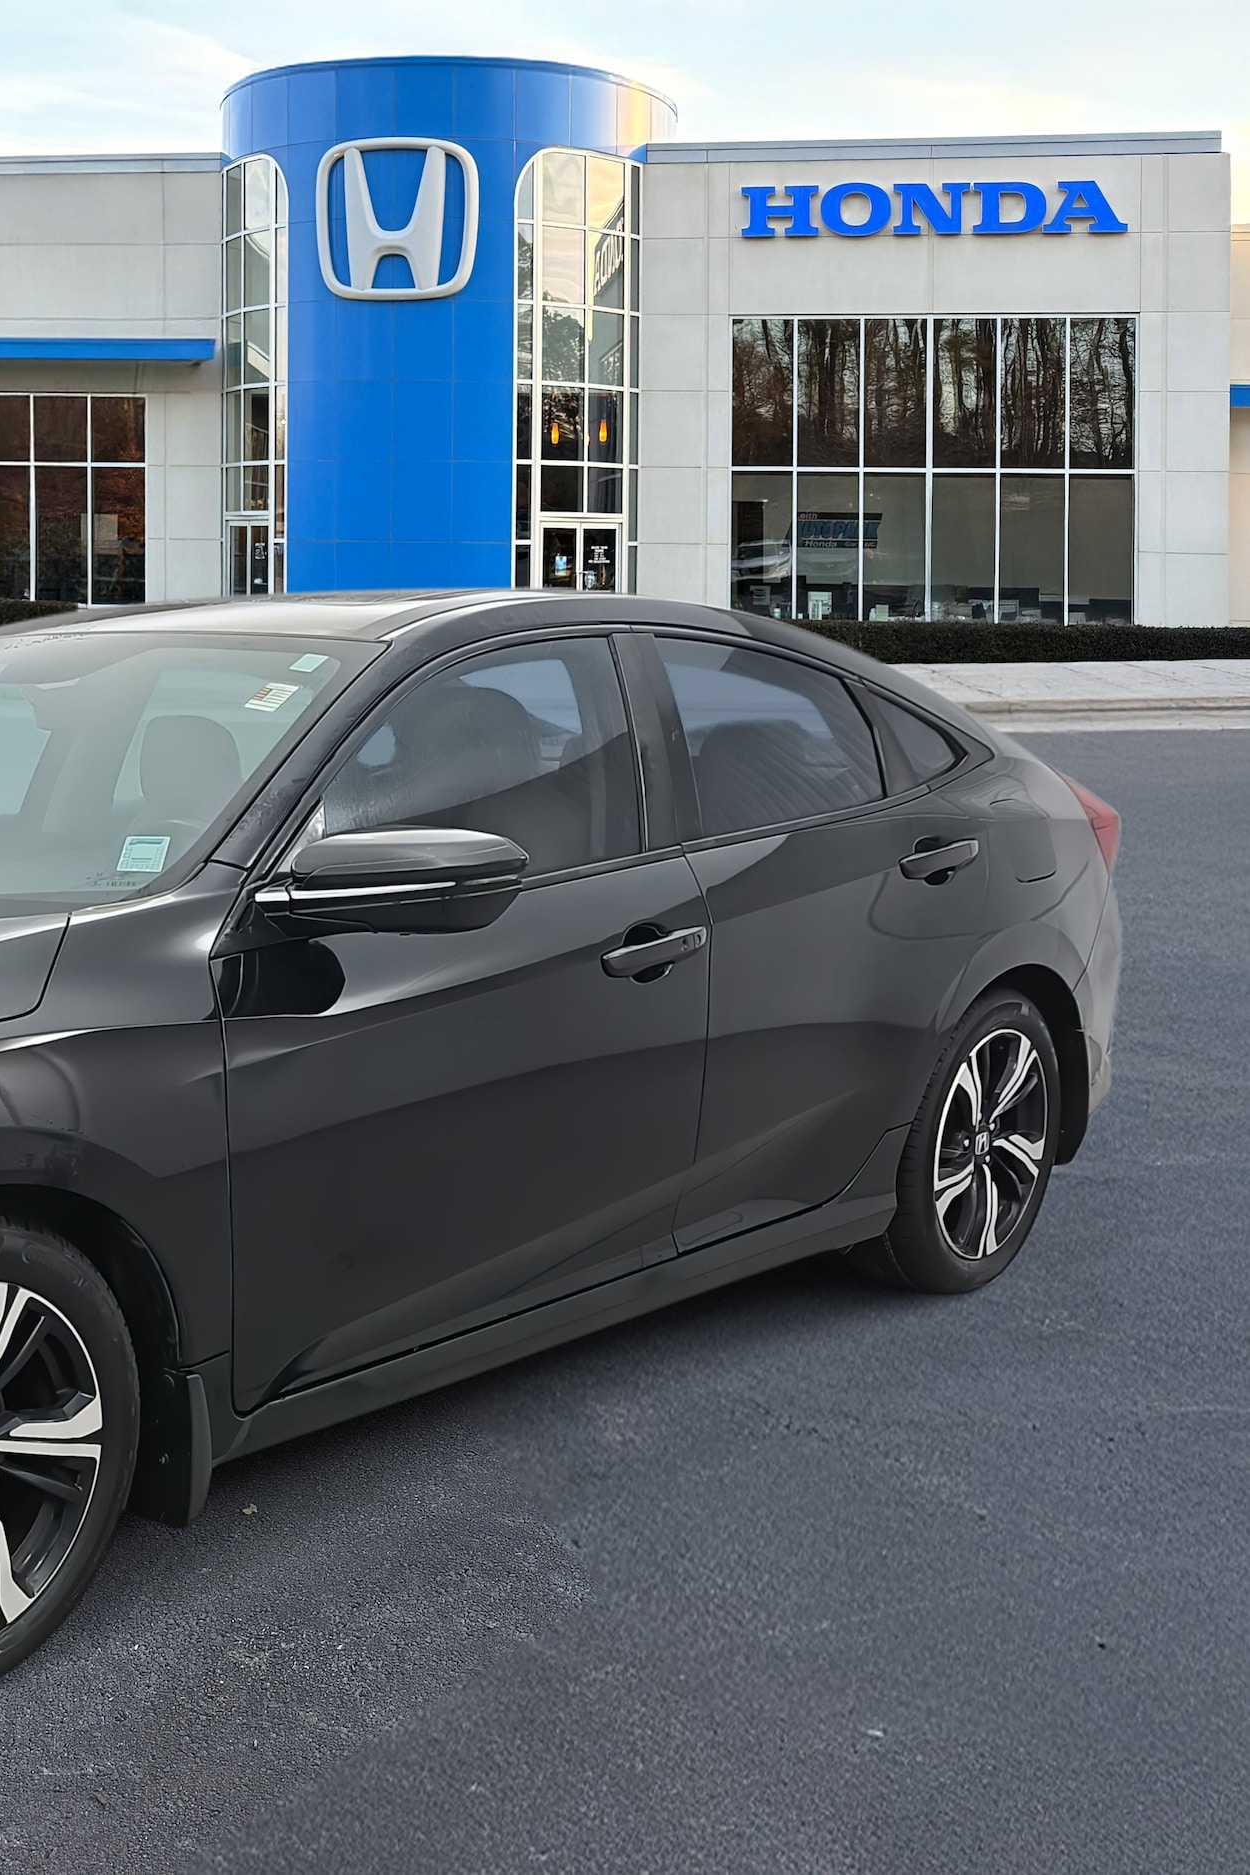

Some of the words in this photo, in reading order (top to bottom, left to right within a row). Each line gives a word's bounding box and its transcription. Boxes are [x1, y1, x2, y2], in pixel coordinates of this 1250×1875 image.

[741, 180, 1129, 237] HONDA
[797, 512, 818, 520] eith
[804, 540, 838, 548] Honda
